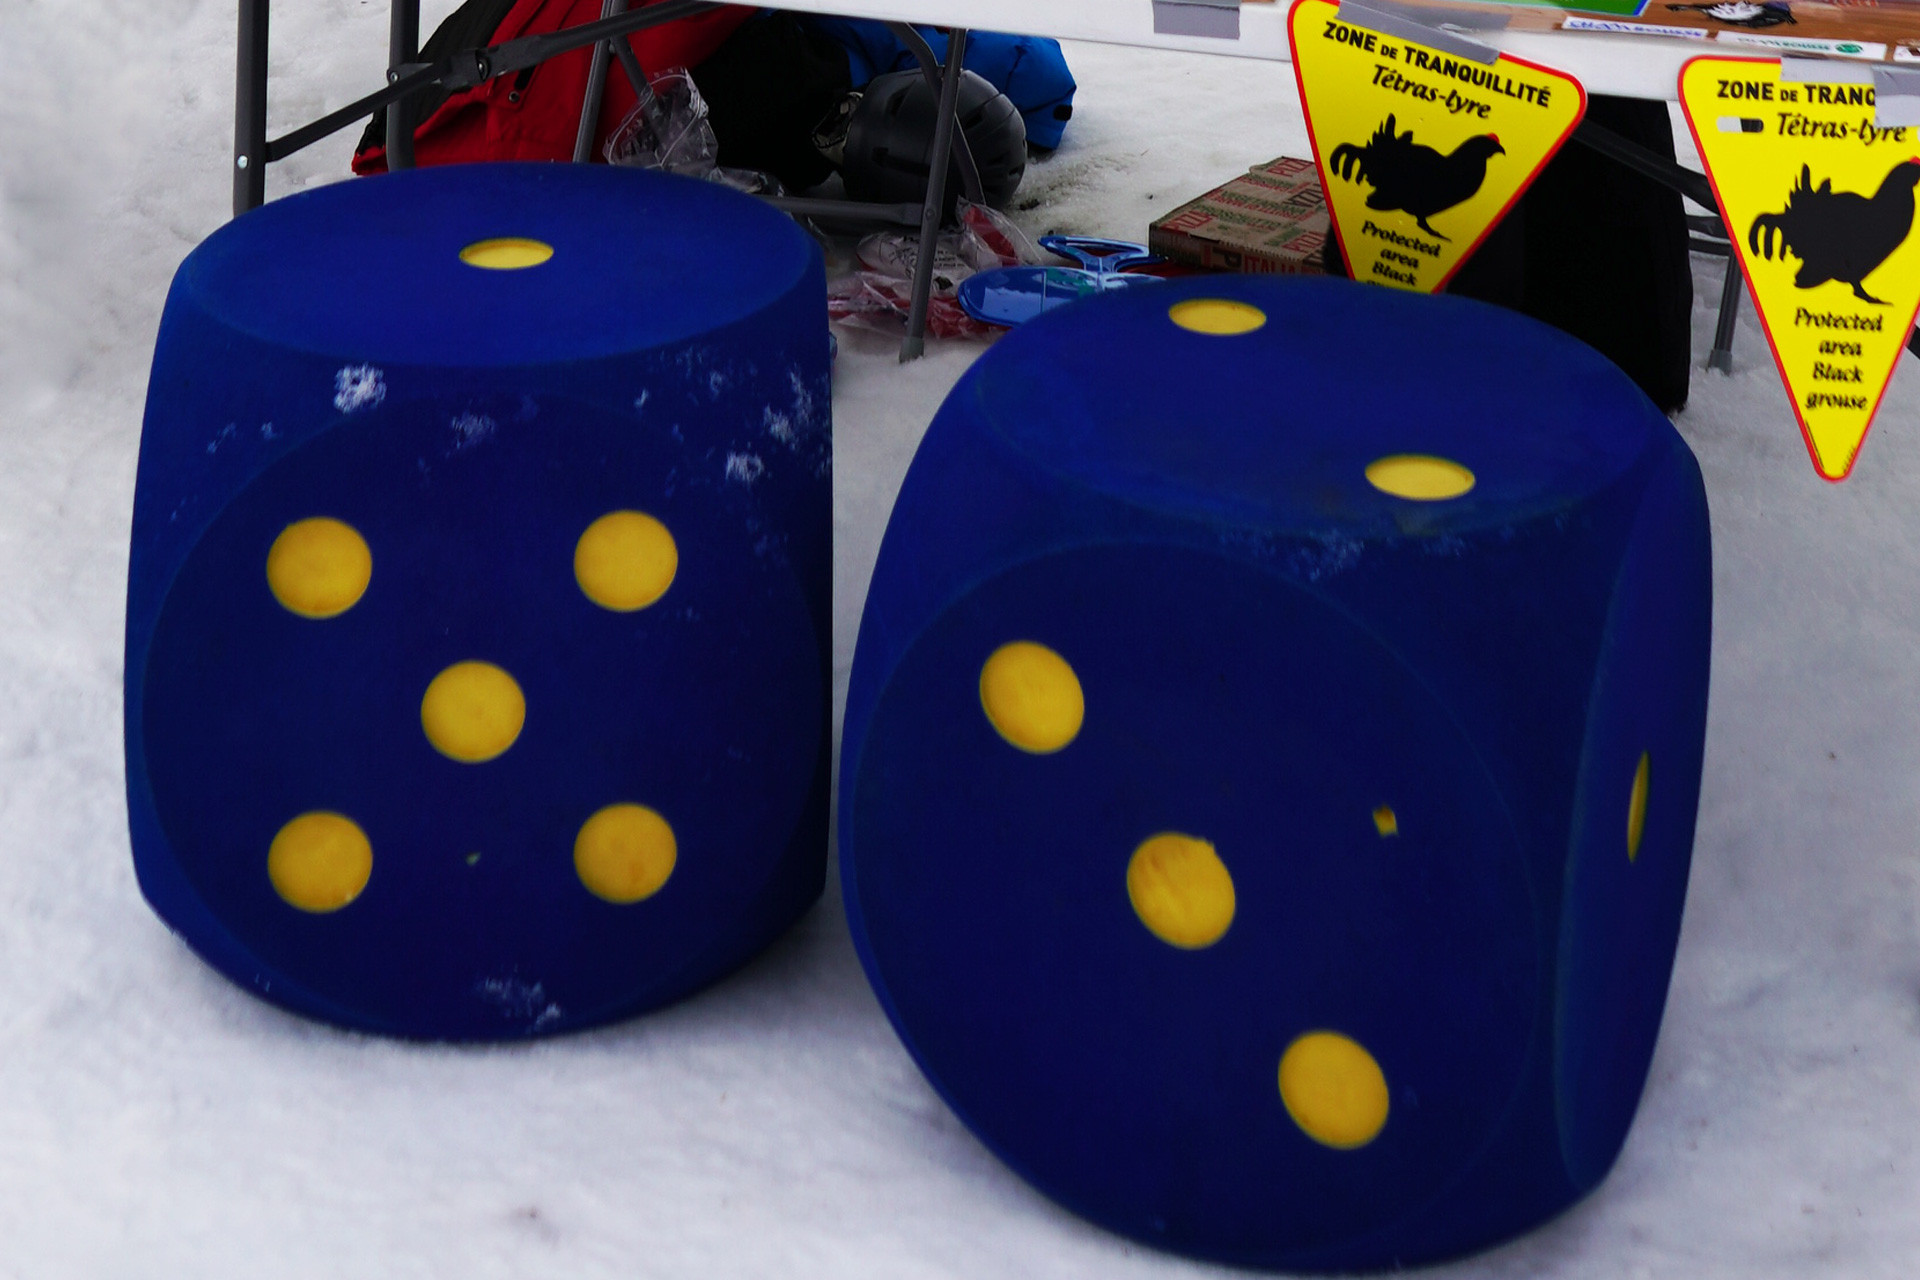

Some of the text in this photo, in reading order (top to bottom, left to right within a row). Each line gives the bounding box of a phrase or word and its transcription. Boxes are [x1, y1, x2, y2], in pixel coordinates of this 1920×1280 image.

[1322, 21, 1551, 108] ZONE DE TRANQUILLITÉ
[1372, 64, 1492, 119] Tétras-lyre
[1717, 80, 1774, 101] ZONE
[1781, 90, 1798, 102] DE
[1777, 112, 1907, 146] Tétras-lyre
[1361, 220, 1441, 258] Protected
[1380, 249, 1419, 269] area
[1372, 261, 1417, 286] Black
[1794, 307, 1883, 331] Protected
[1819, 340, 1863, 356] area
[1812, 361, 1863, 383] Black
[1805, 392, 1868, 410] grouse
